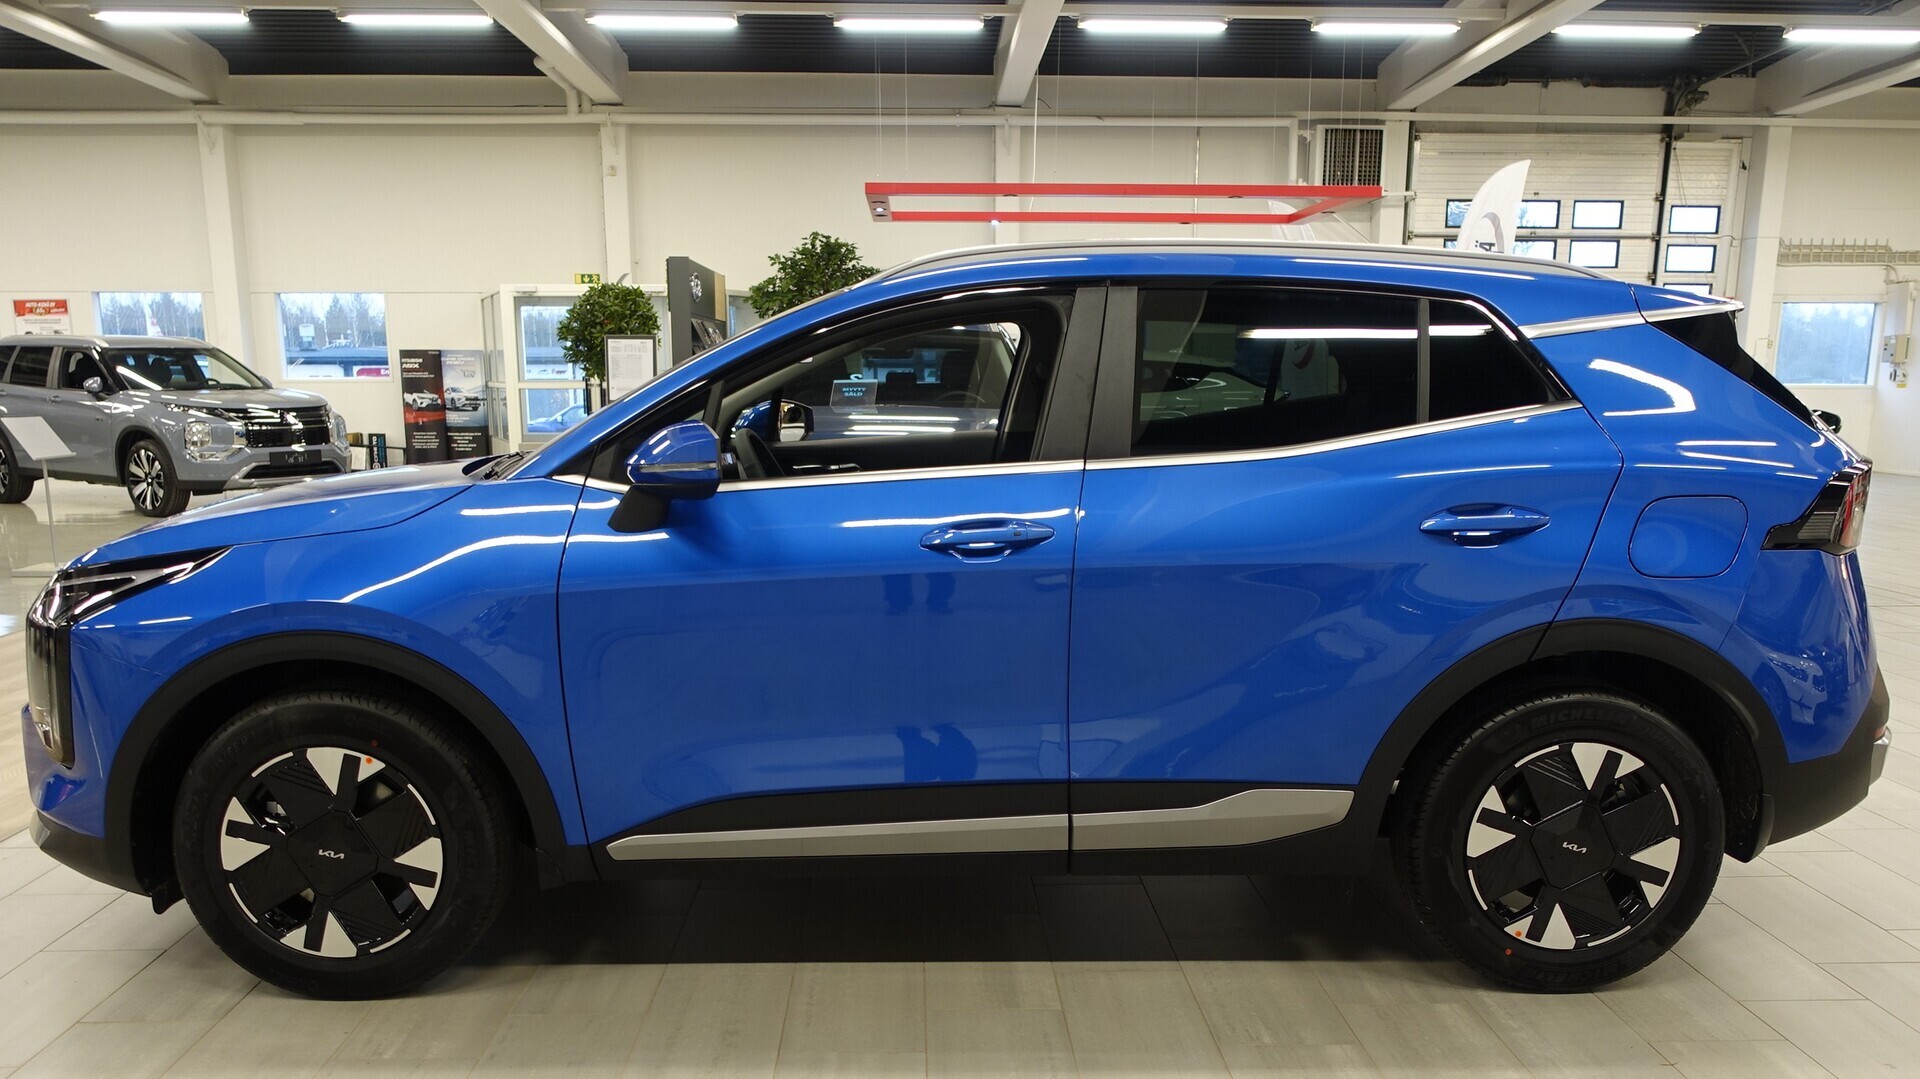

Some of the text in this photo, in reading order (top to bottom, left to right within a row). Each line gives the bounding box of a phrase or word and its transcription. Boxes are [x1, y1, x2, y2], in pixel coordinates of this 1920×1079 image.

[1531, 708, 1630, 730] MICHELIN
[1562, 841, 1587, 854] KIA
[318, 849, 345, 860] KIA
